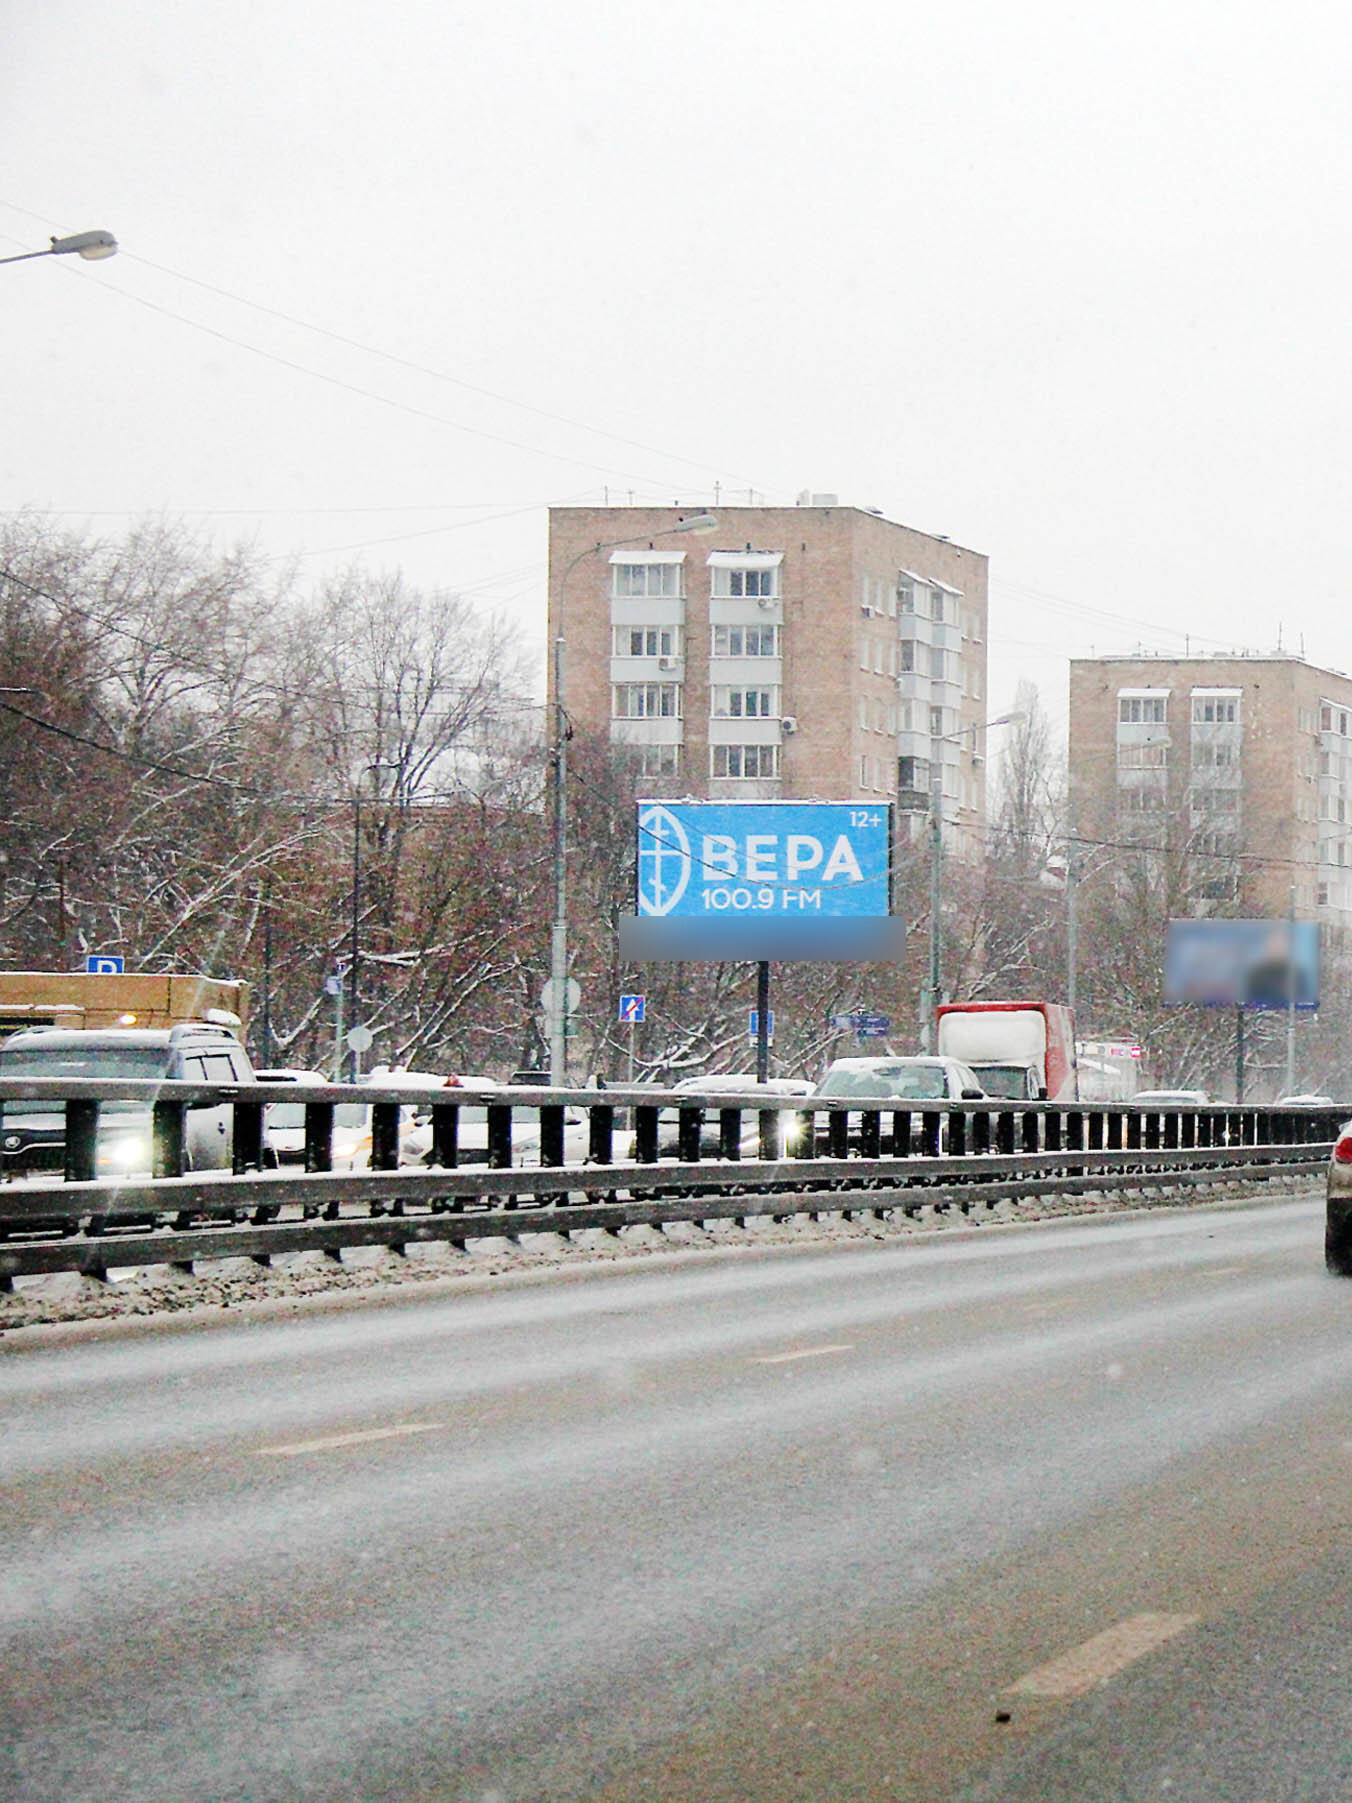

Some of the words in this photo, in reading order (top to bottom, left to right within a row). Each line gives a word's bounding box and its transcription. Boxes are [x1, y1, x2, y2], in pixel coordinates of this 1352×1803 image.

[849, 811, 882, 828] 12+
[702, 834, 865, 882] ВЕРА
[701, 887, 774, 910] 100.9
[783, 888, 822, 910] FM
